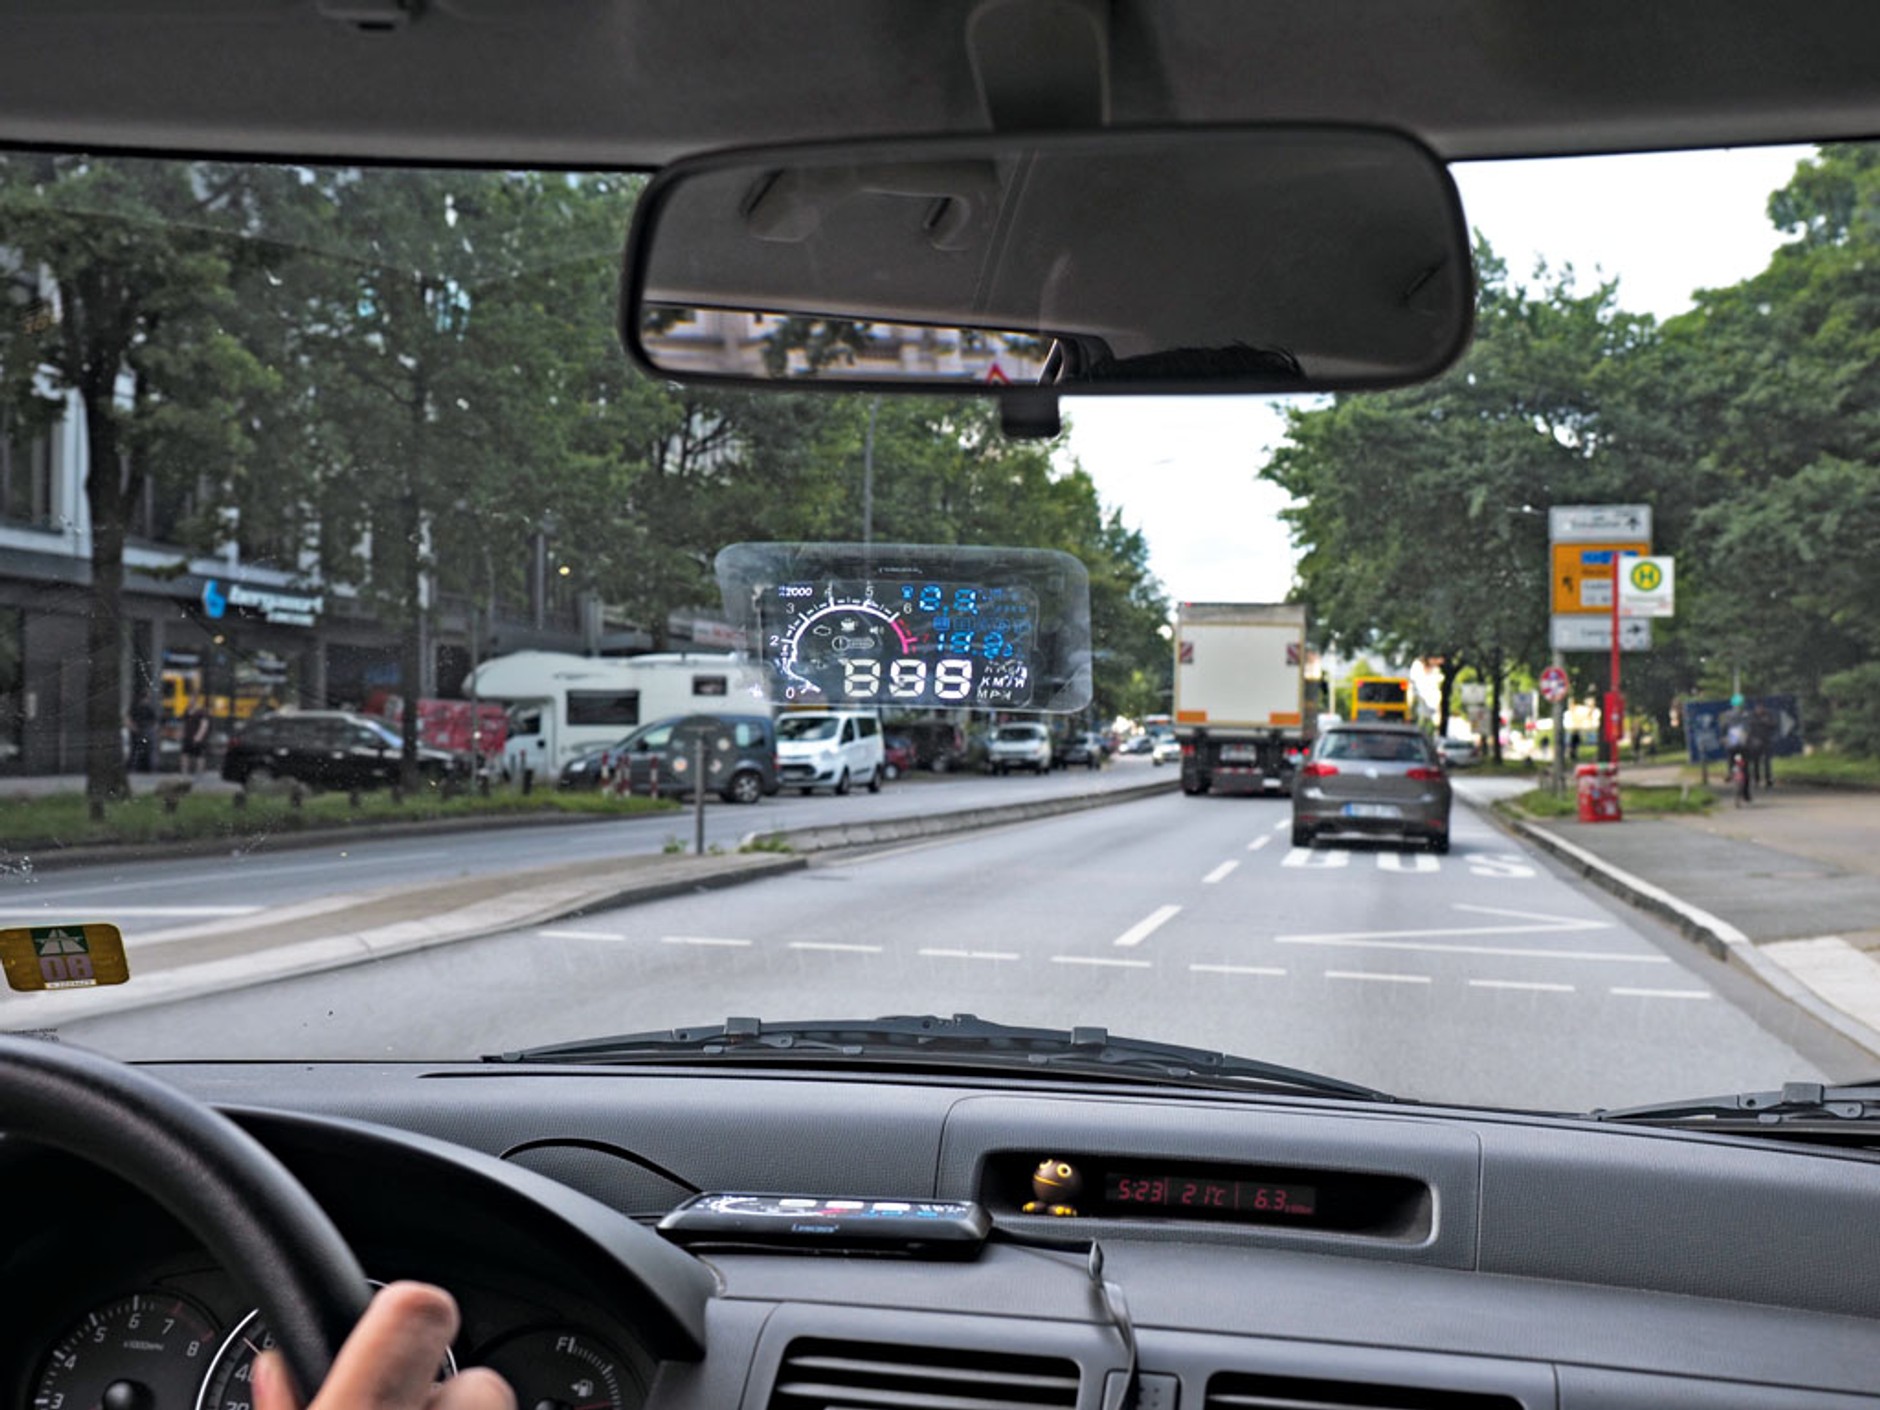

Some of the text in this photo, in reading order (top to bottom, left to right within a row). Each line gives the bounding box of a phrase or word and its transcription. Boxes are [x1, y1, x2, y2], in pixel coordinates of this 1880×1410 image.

[785, 602, 794, 614] 3
[902, 602, 911, 613] 6
[769, 635, 778, 646] 2
[784, 686, 794, 699] 0
[1119, 1179, 1163, 1202] 5:23
[1254, 1188, 1287, 1211] 6.3
[128, 1314, 140, 1329] 6
[162, 1319, 174, 1335] 7
[94, 1327, 107, 1343] 5
[187, 1341, 200, 1357] 8
[556, 1336, 569, 1351] F
[64, 1355, 77, 1370] 4
[50, 1393, 64, 1410] 3
